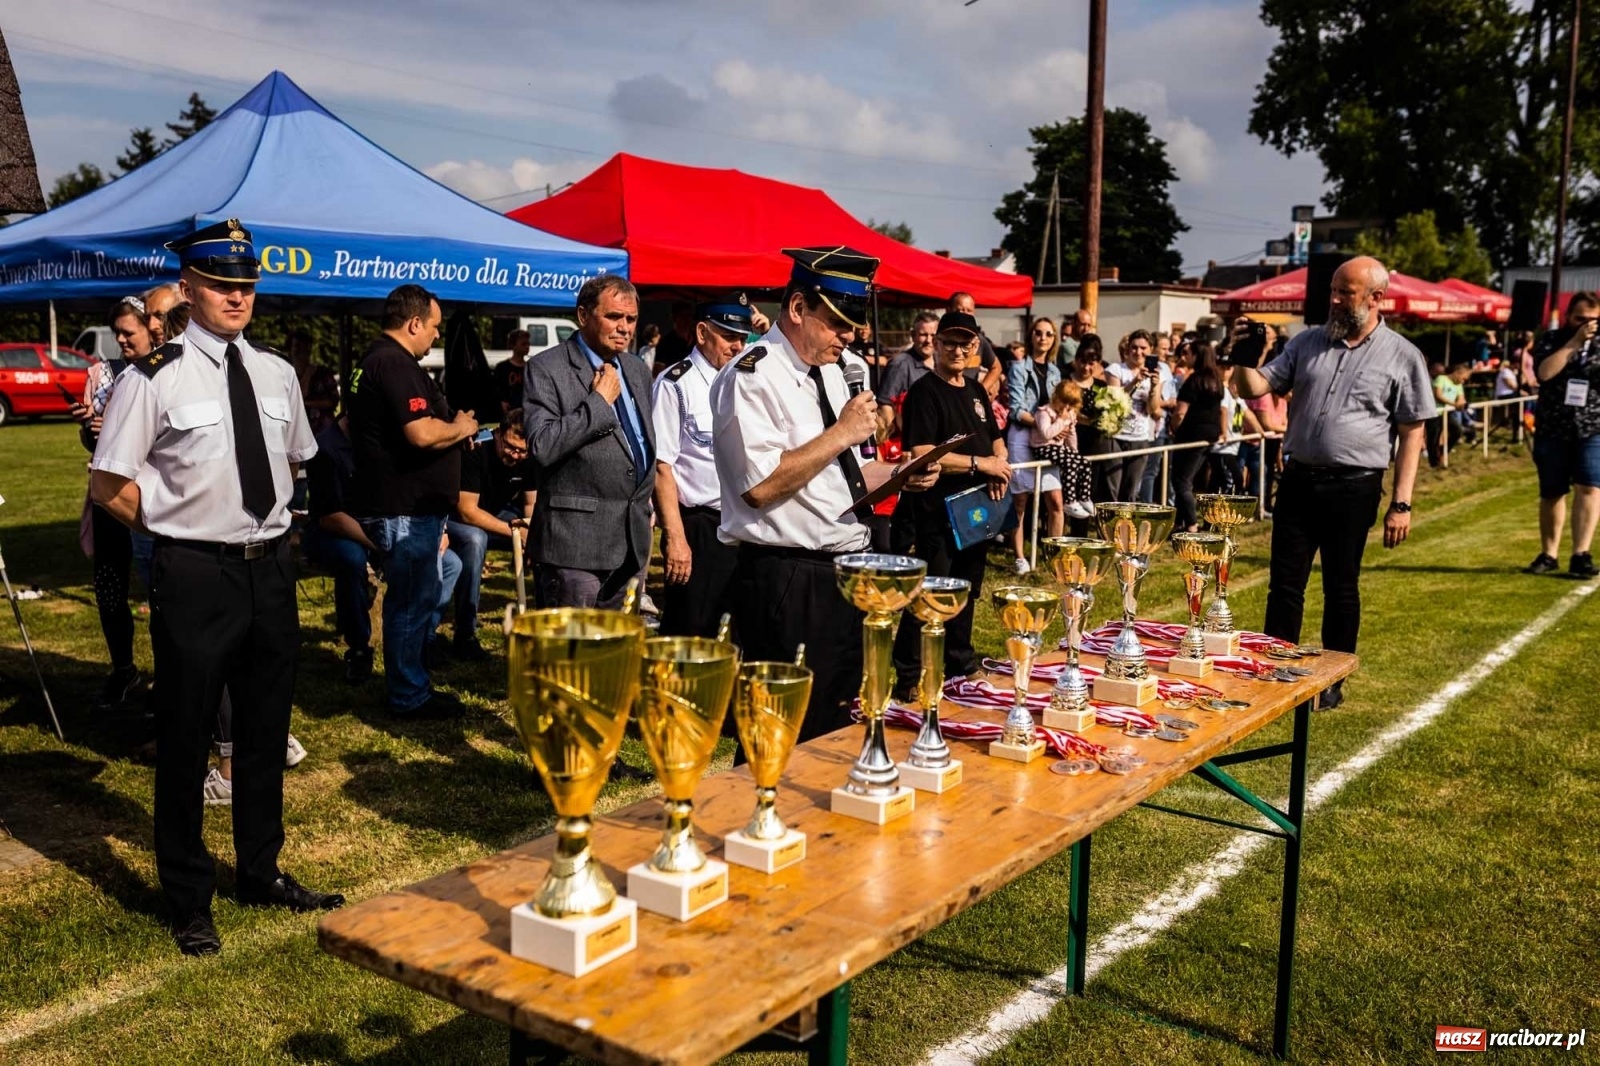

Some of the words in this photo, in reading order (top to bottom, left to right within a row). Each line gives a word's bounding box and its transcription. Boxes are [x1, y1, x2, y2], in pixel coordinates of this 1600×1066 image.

[0, 257, 64, 286] tnerstwo
[67, 250, 91, 280] dla
[94, 249, 166, 281] Rozwoju
[258, 244, 313, 275] GD
[475, 257, 509, 286] dla
[514, 262, 607, 297] Rozwoj”
